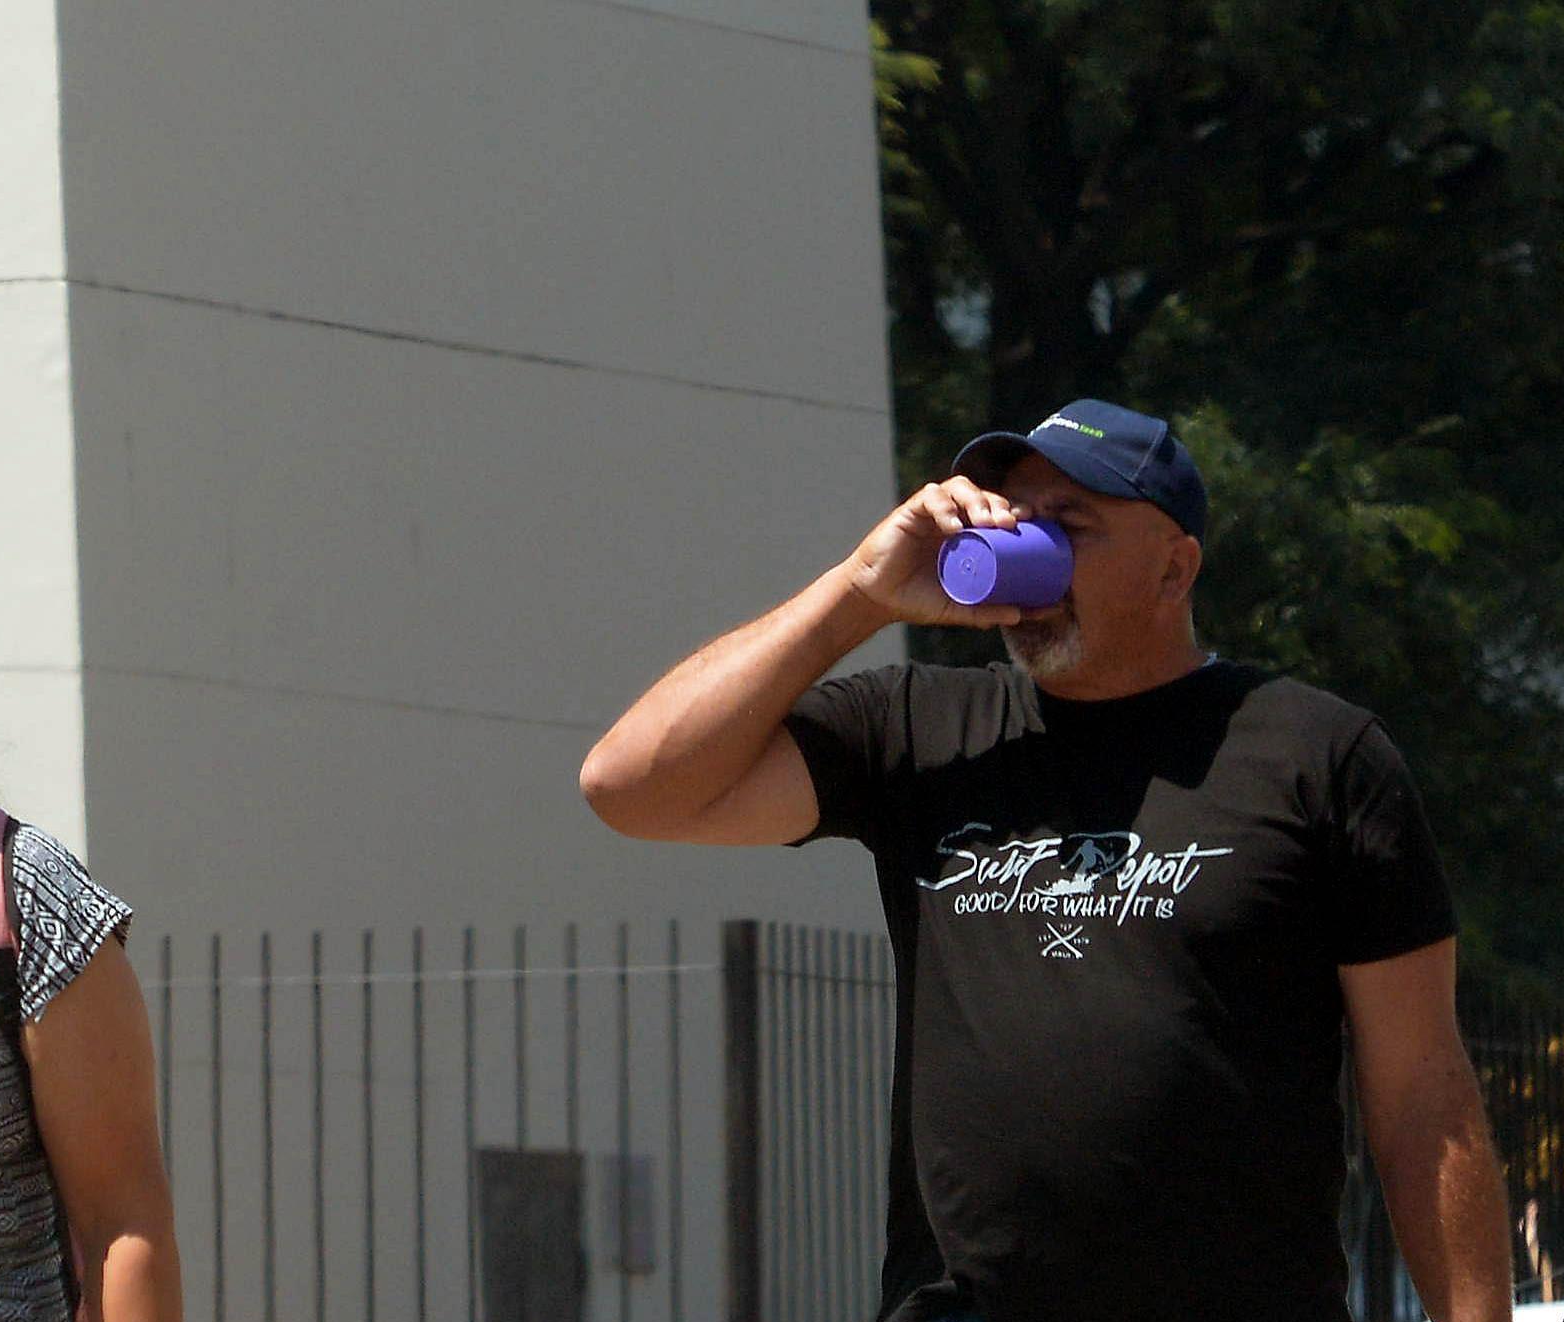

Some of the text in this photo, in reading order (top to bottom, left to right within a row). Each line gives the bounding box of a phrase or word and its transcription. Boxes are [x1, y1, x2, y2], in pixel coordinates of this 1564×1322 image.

[916, 822, 1234, 926] Surf Depot
[953, 892, 1174, 919] GOOD FOR WHAT IT IS
